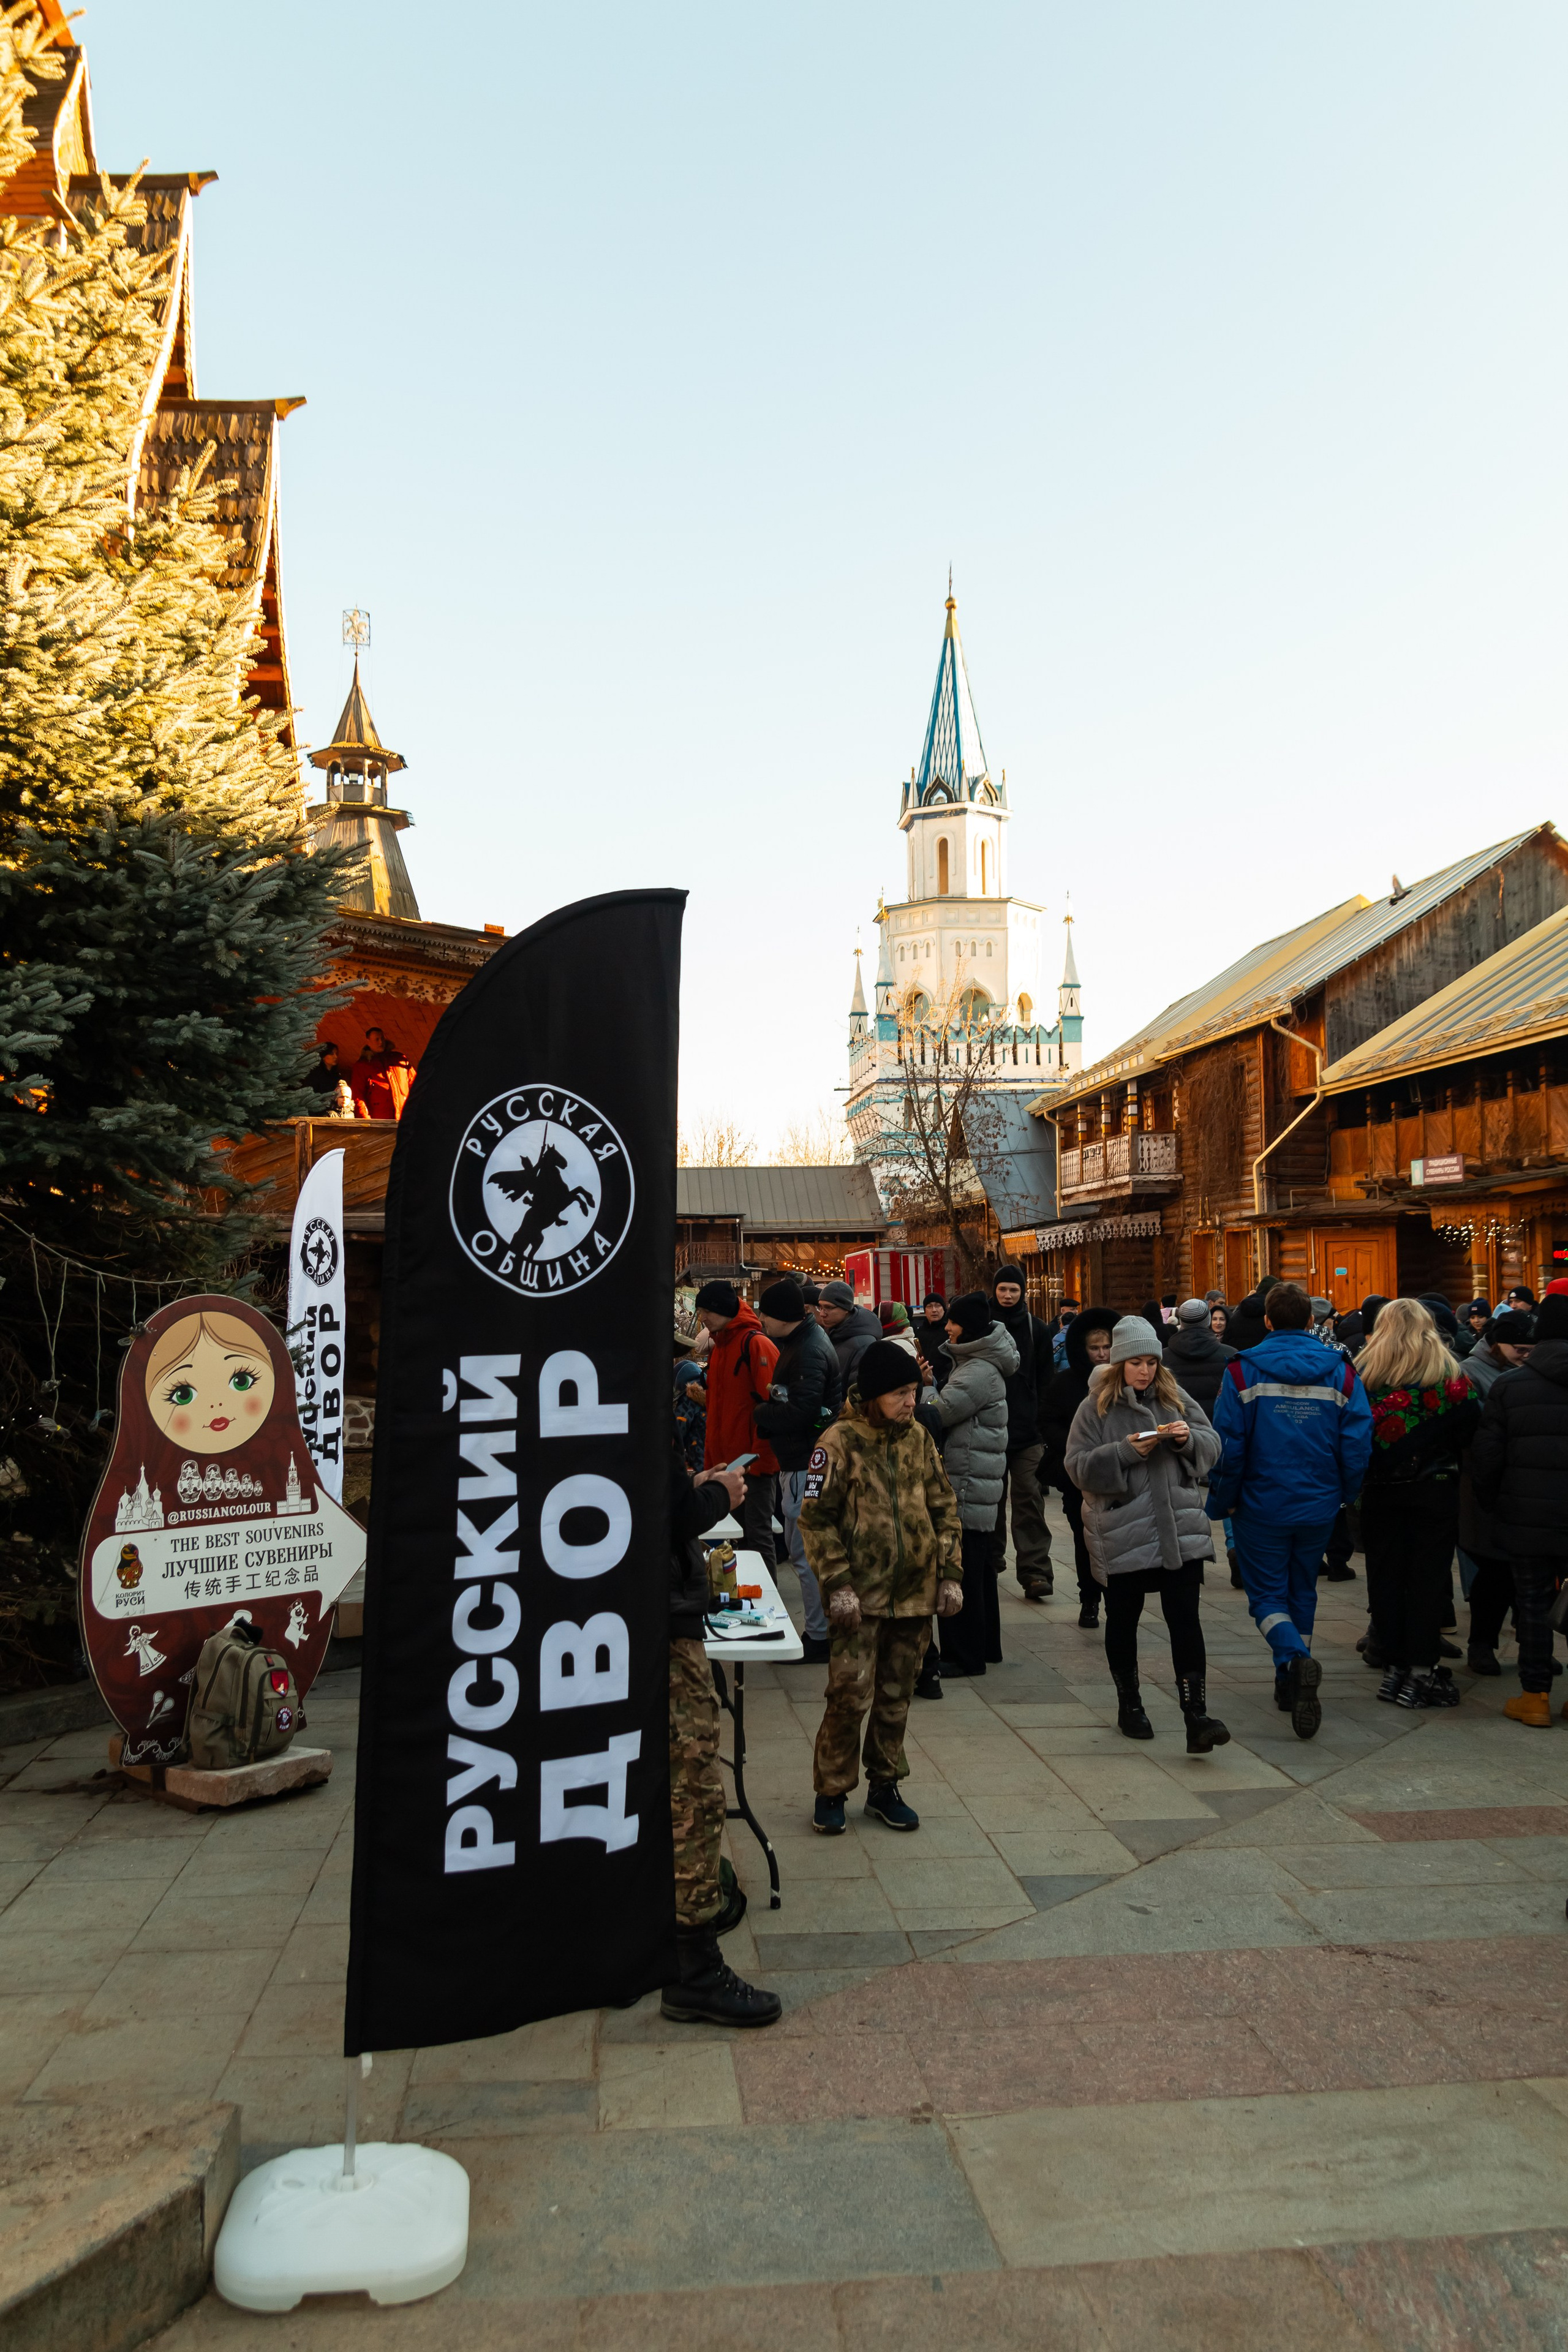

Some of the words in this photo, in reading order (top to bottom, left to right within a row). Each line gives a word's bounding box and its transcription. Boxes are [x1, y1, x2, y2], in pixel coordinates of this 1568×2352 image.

[466, 1091, 619, 1158] РУССКАЯ
[471, 1230, 612, 1290] ОБЩИНА
[319, 1303, 342, 1466] ДВОР
[167, 1502, 271, 1525] @RUSSIANCOLOUR
[171, 1537, 199, 1553] THE
[205, 1532, 240, 1549] BEST
[246, 1523, 324, 1544] SOUVENIRS
[162, 1554, 238, 1579] ЛУЧШИЕ
[245, 1542, 333, 1568] СУВЕНИРЫ
[116, 1590, 146, 1599] КОЛОРИТ
[184, 1565, 318, 1599] 传统手工纪念品
[116, 1596, 145, 1608] РУСИ
[443, 1352, 522, 1874] РУССКИЙ
[538, 1349, 642, 1855] ДВОР
